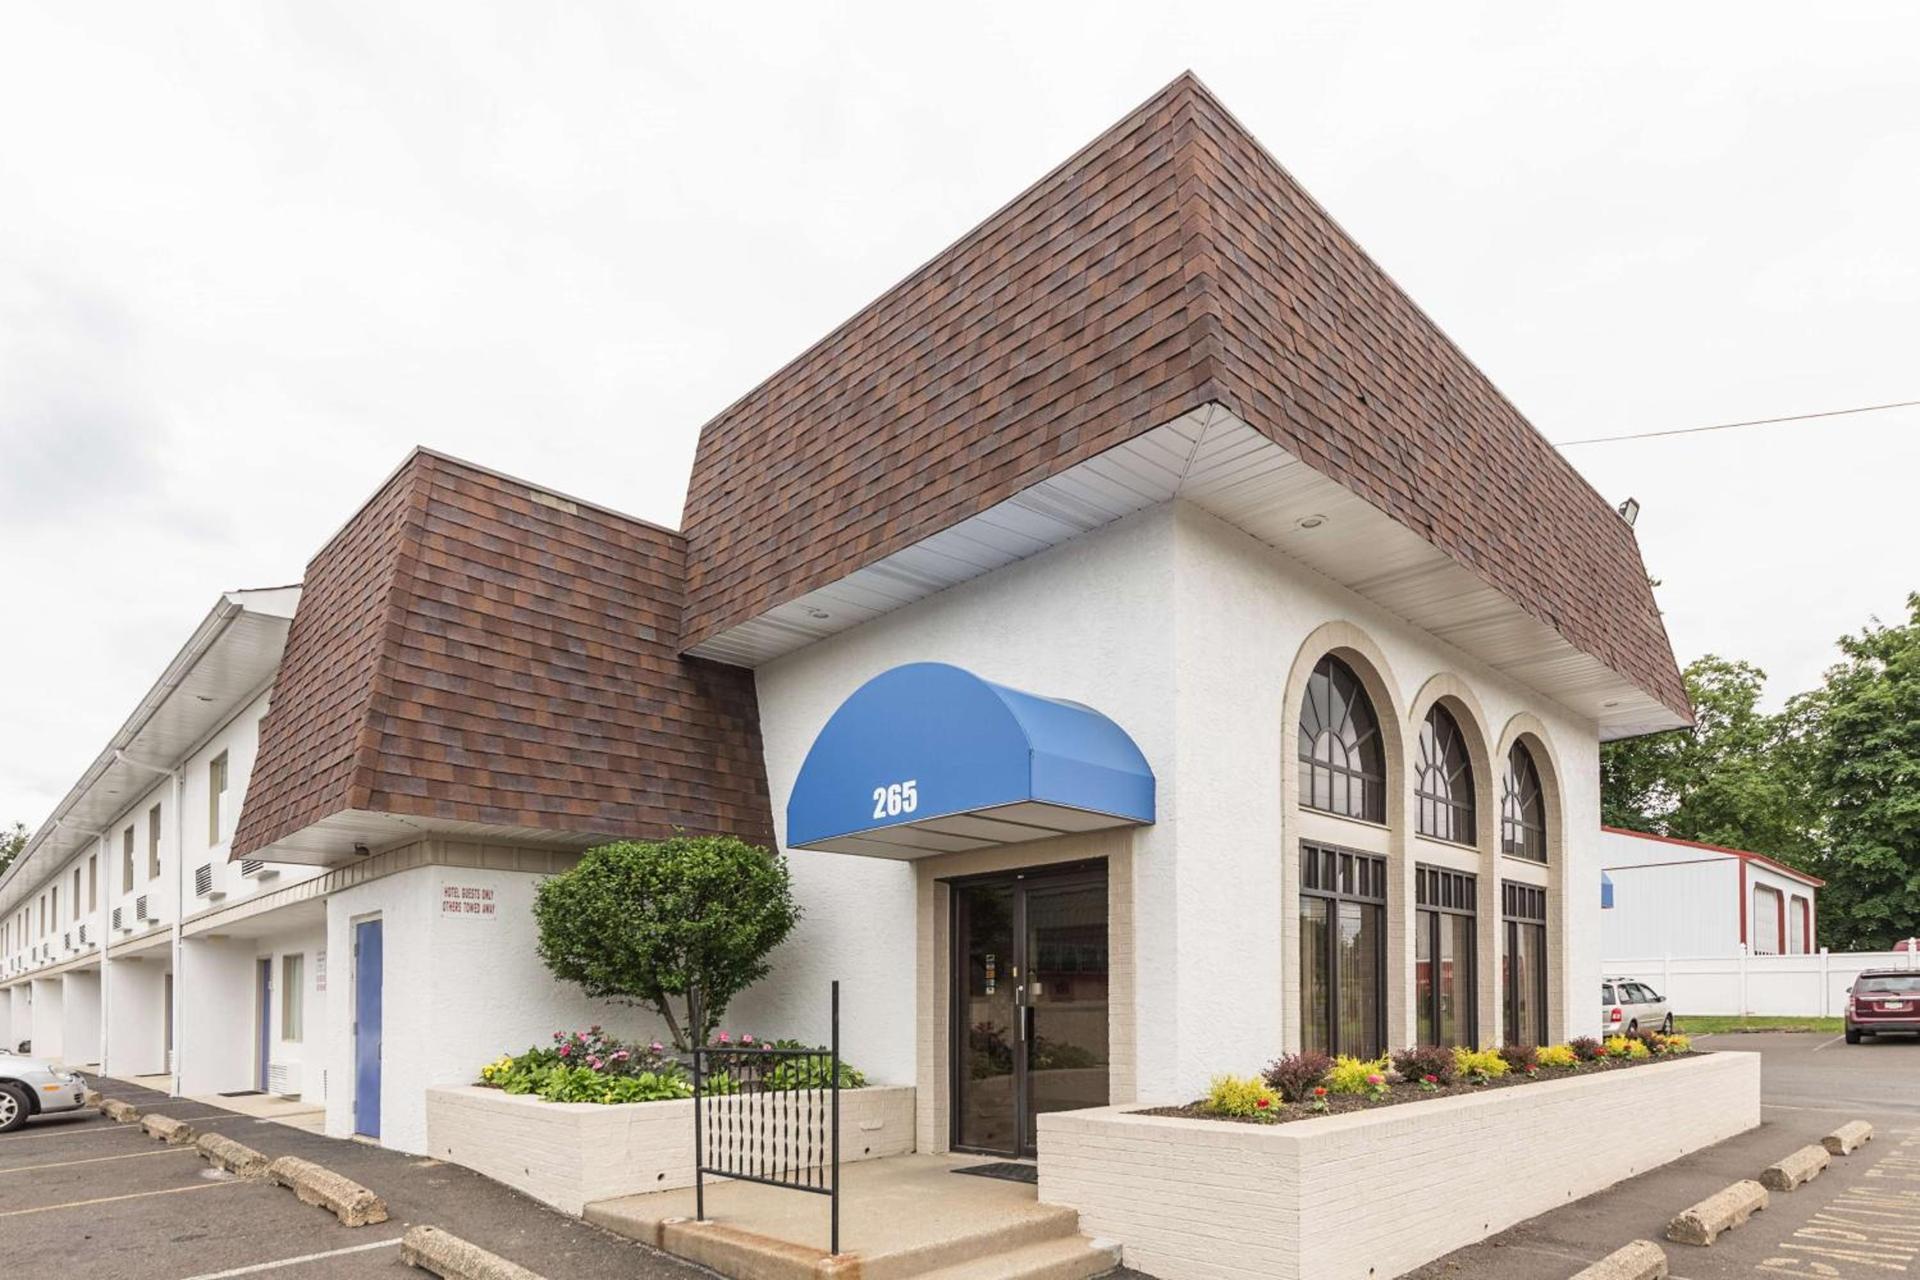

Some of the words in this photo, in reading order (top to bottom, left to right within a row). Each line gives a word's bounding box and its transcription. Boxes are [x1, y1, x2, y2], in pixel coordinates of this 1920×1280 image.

[873, 780, 918, 820] 265
[462, 888, 480, 899] GUESTS
[482, 889, 494, 900] ONLY
[443, 901, 461, 912] OTHERS
[463, 902, 480, 913] TOWED
